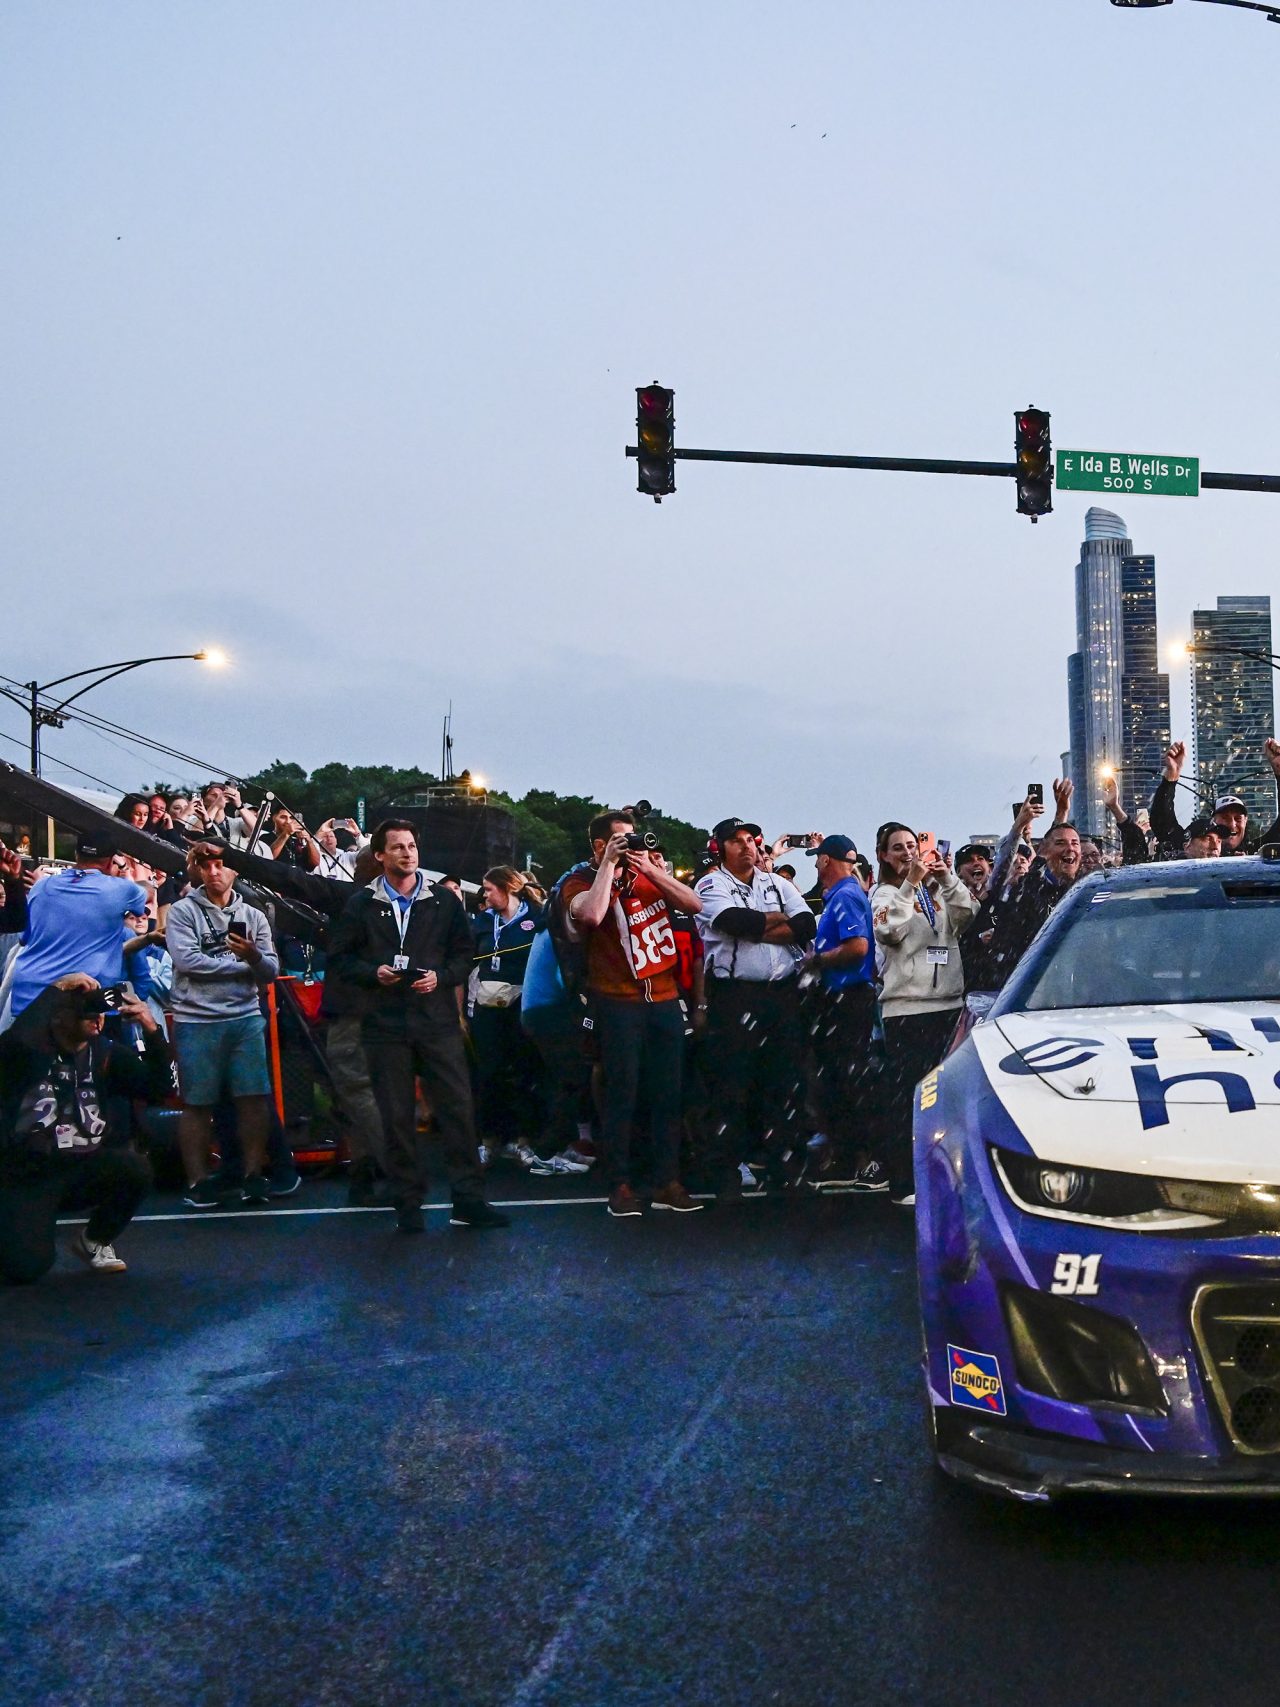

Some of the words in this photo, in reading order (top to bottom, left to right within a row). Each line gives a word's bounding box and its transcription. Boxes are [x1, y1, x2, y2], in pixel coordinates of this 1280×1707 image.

[1064, 459, 1073, 471] E
[1080, 456, 1103, 473] Ida
[1109, 457, 1124, 474] B.
[1128, 458, 1169, 477] Wells
[1175, 465, 1191, 478] Dr
[1103, 477, 1134, 489] 500
[1143, 478, 1153, 490] S
[1050, 1253, 1103, 1295] 91
[954, 1369, 998, 1393] SUNOCO
